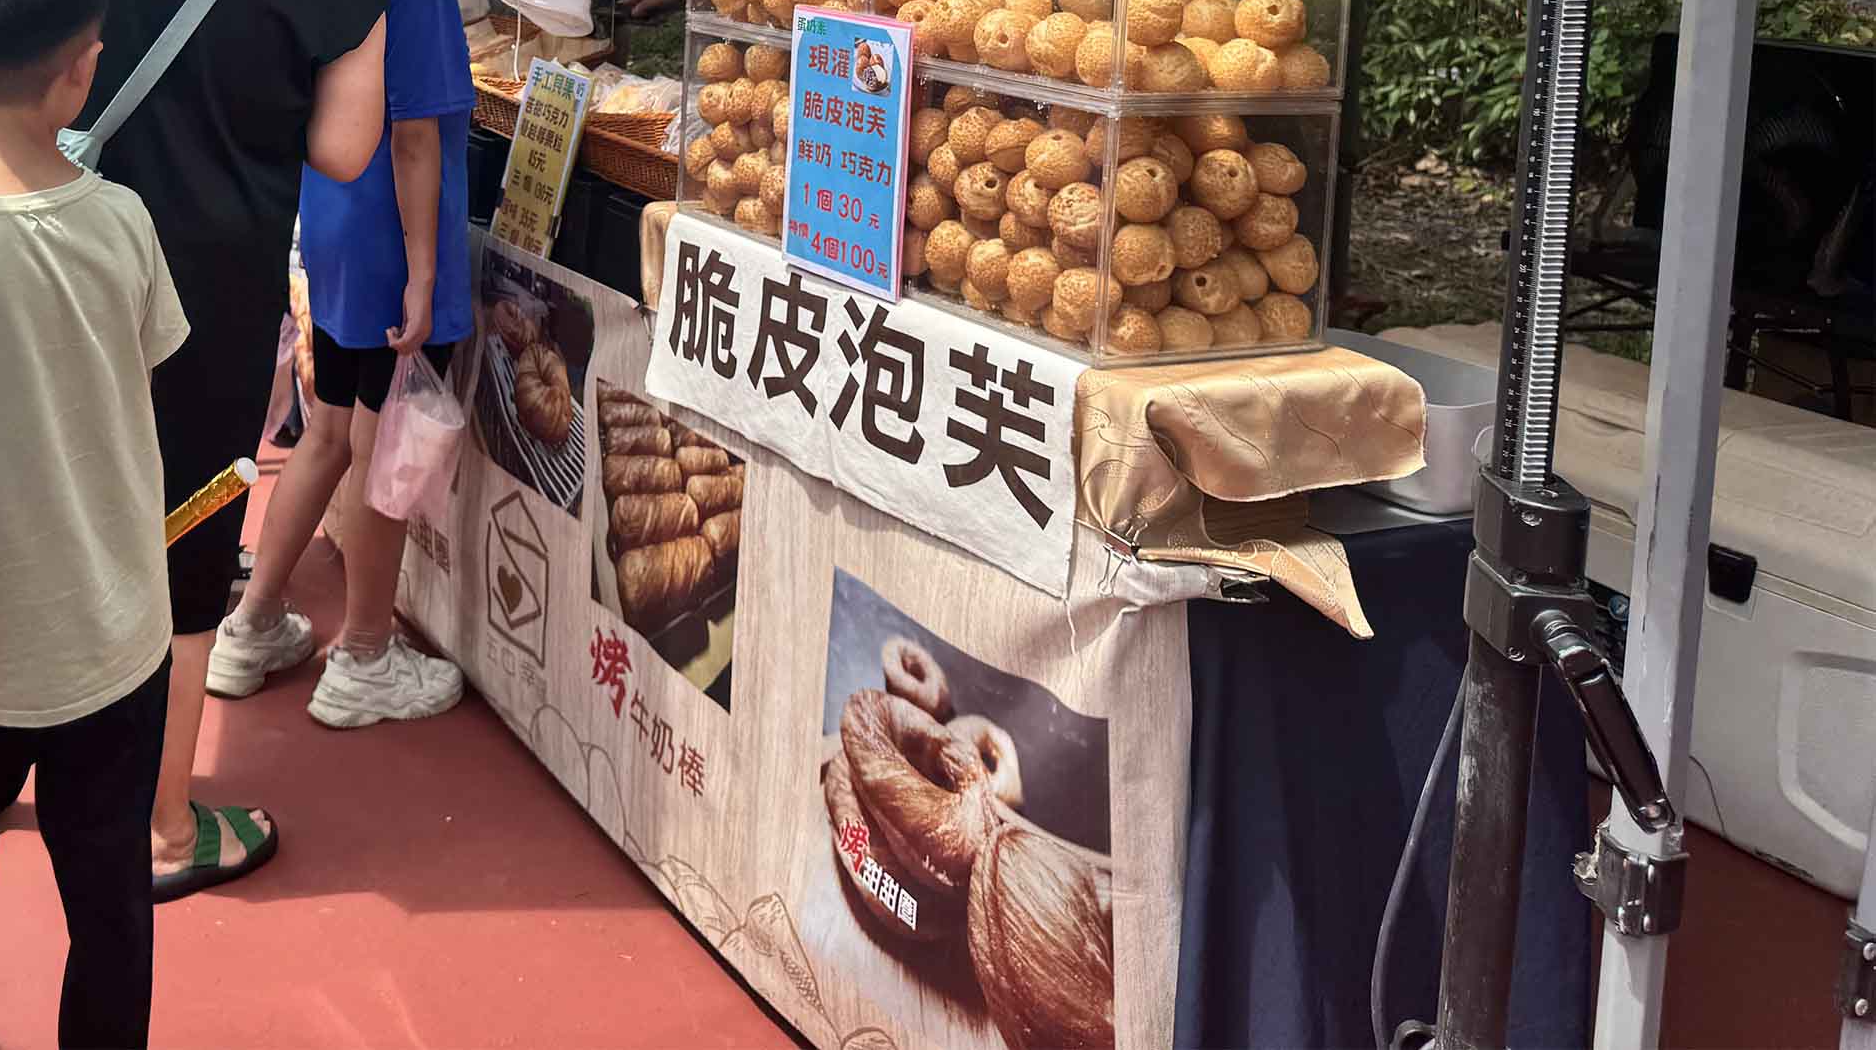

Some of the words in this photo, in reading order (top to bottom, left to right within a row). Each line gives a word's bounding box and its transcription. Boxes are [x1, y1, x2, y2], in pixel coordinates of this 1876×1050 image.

[808, 44, 851, 79] 現灌
[803, 90, 887, 139] 脆皮泡芙
[798, 138, 832, 167] 鮮奶
[840, 150, 892, 187] 巧克力
[669, 241, 1056, 530] 脆皮泡芙
